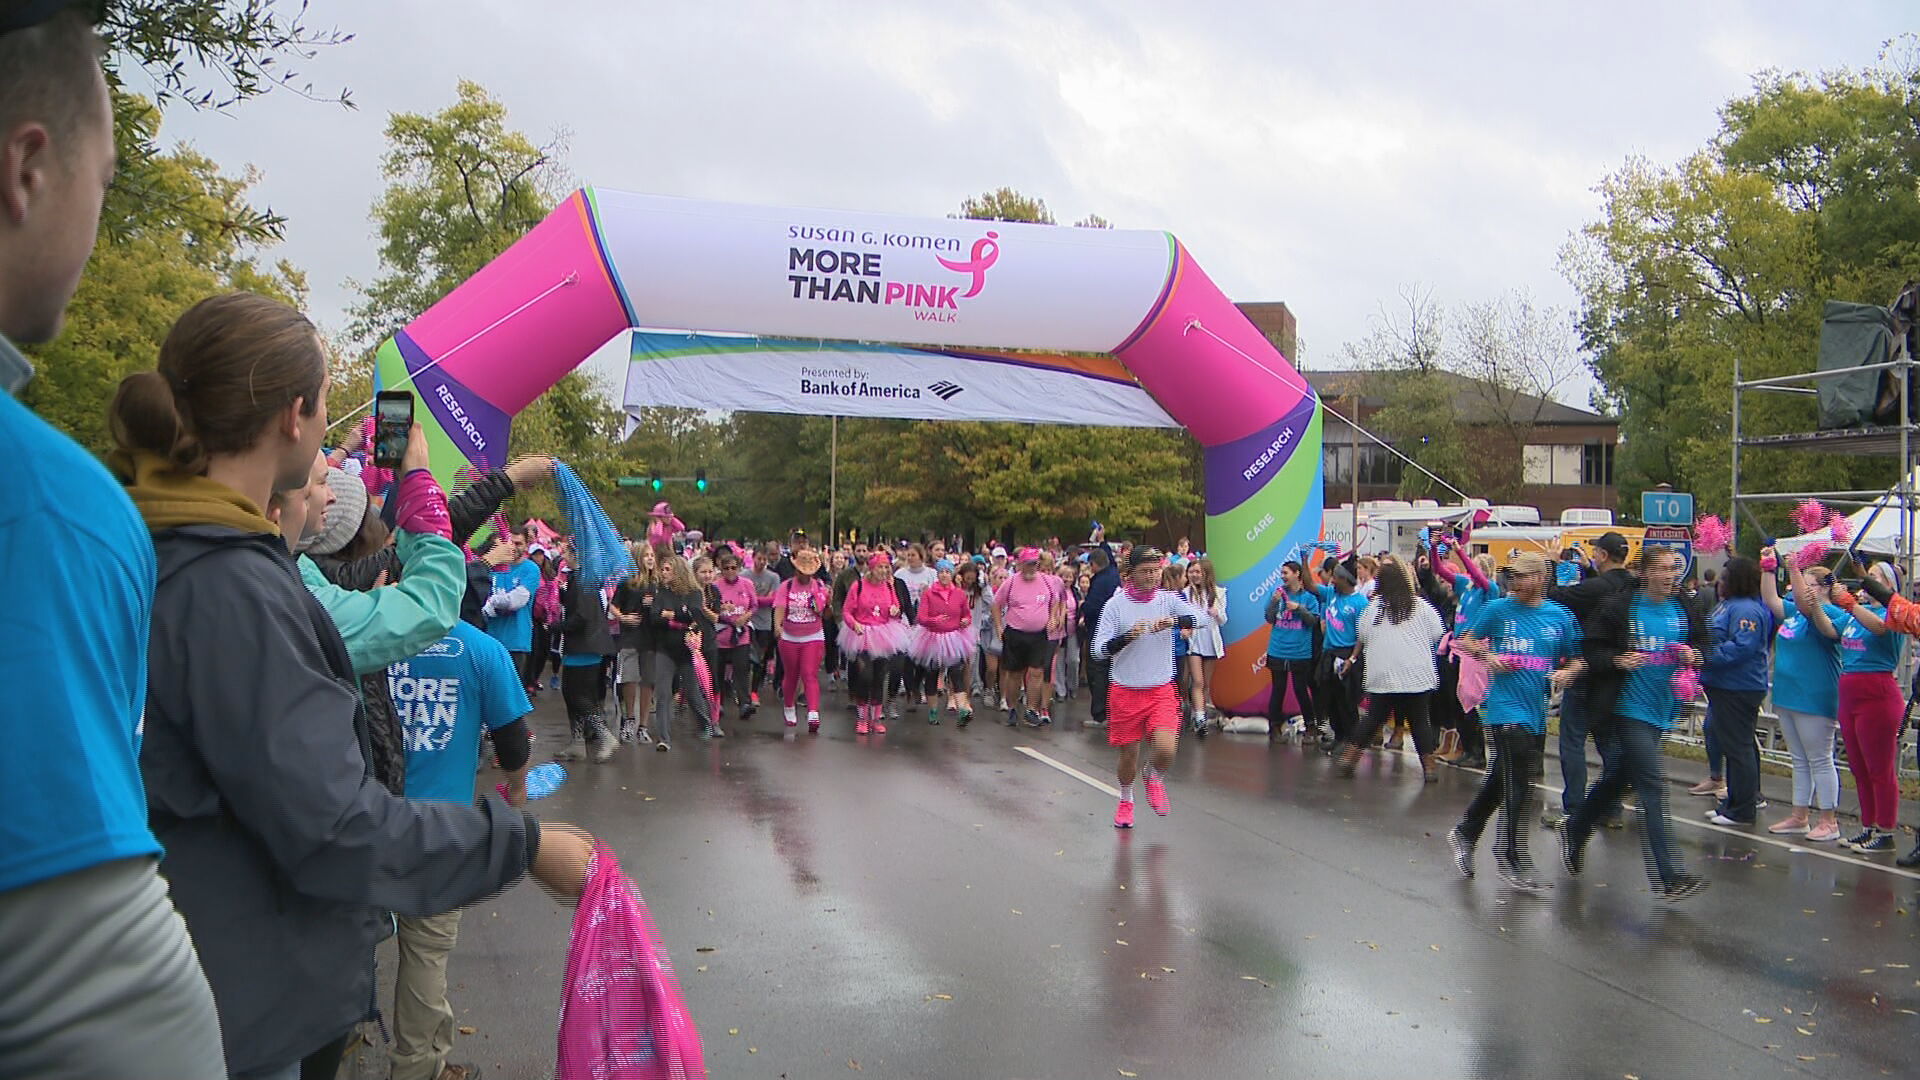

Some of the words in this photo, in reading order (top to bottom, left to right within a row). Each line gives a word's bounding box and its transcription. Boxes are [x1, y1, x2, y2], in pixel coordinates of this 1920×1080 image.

[861, 231, 878, 245] G.
[788, 247, 882, 277] MORE
[788, 275, 881, 304] THAN
[884, 282, 960, 310] PINK
[914, 310, 957, 323] WALK
[801, 366, 851, 379] Presented
[854, 368, 869, 381] by:
[801, 379, 839, 395] Bank
[841, 382, 856, 396] of
[858, 382, 921, 399] America
[435, 383, 487, 451] RESEARCH
[1243, 427, 1294, 481] RESEARCH
[1655, 500, 1680, 517] TO
[1246, 513, 1275, 541] CARE
[1325, 530, 1351, 543] otion
[1649, 529, 1685, 539] INTERSTATE
[395, 701, 458, 726] HAN
